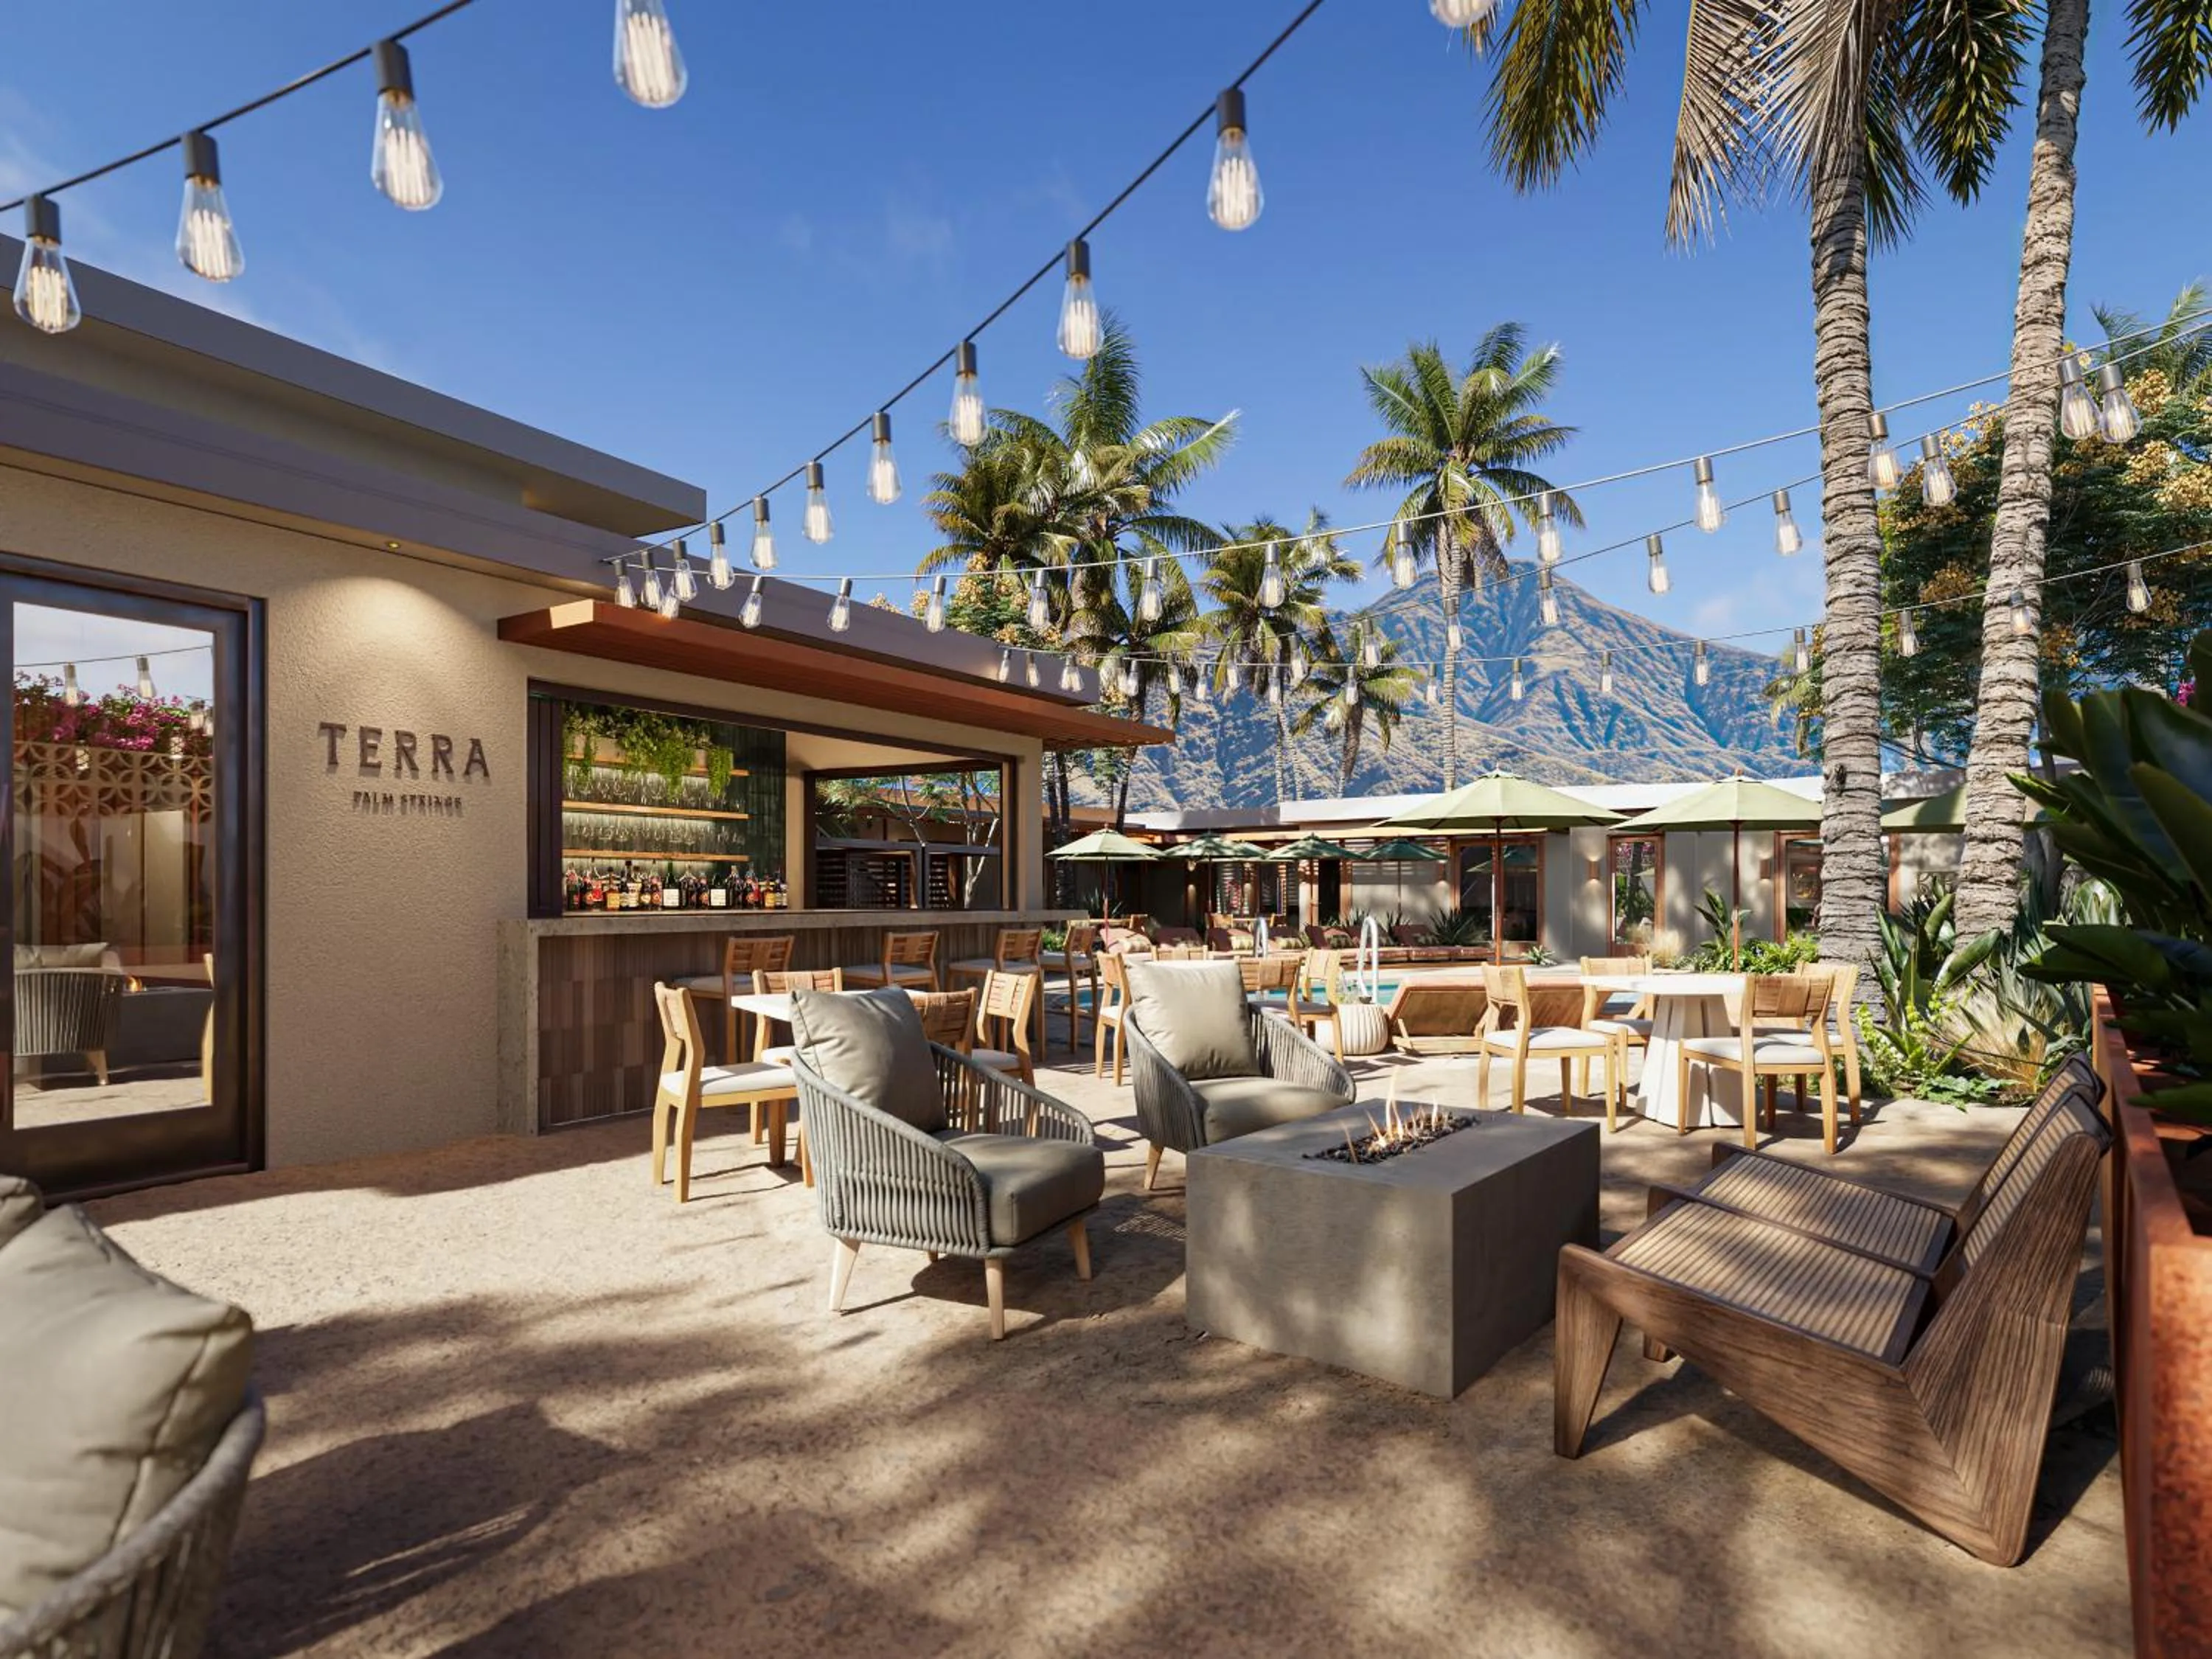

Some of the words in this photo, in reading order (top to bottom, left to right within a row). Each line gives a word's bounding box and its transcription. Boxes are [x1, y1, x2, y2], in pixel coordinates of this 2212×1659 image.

[319, 722, 490, 779] TERRA
[353, 791, 393, 807] PALM
[400, 793, 462, 810] SPRINGS
